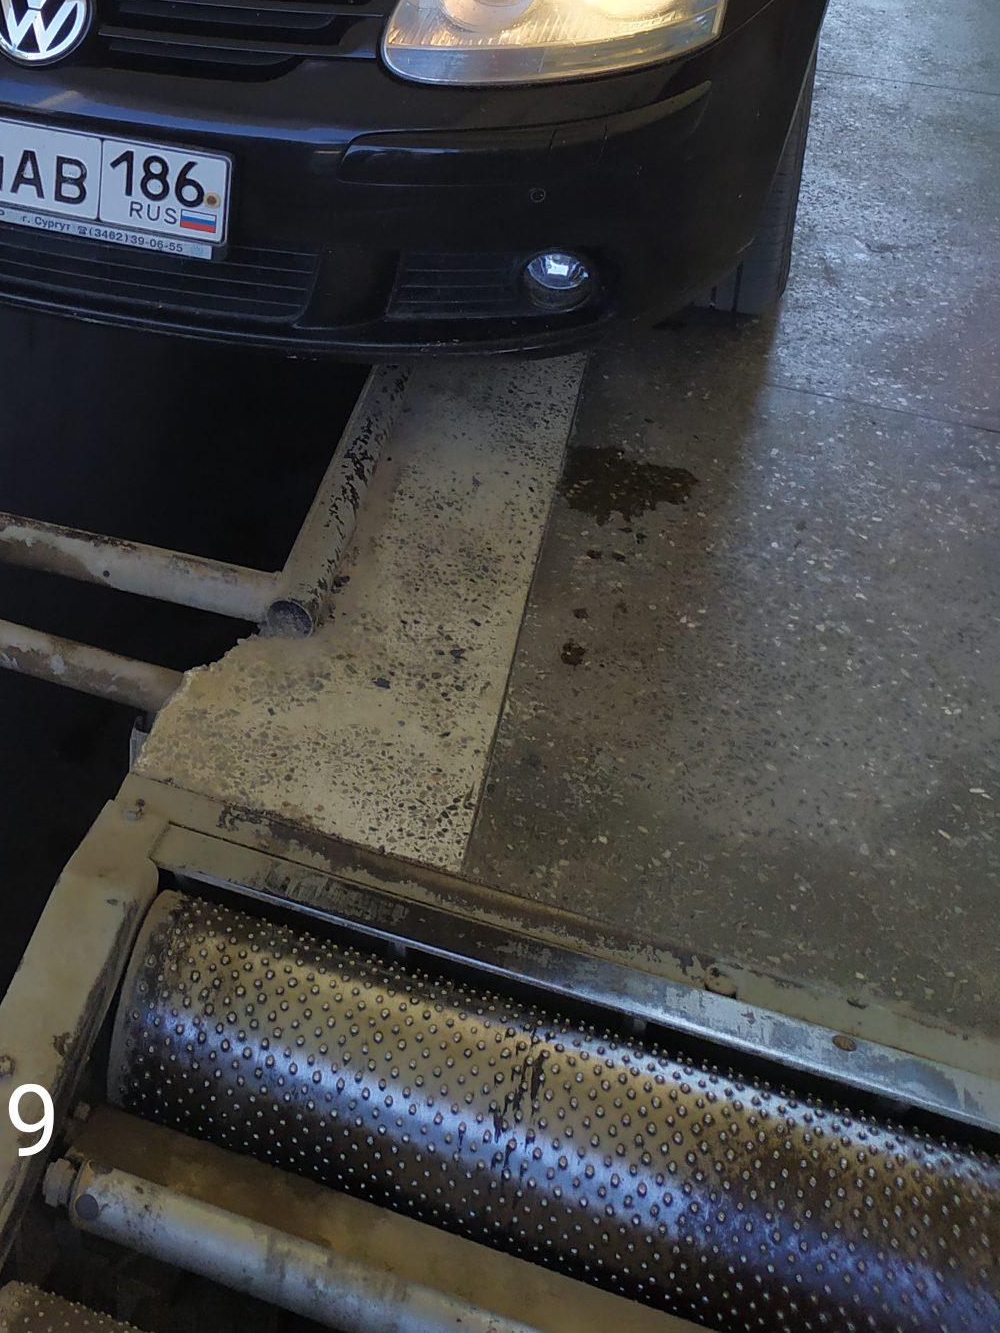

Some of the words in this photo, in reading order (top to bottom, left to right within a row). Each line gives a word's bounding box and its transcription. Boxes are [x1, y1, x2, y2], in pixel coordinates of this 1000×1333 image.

[109, 150, 205, 209] 186
[34, 216, 72, 232] Сургут
[129, 200, 178, 225] RUS
